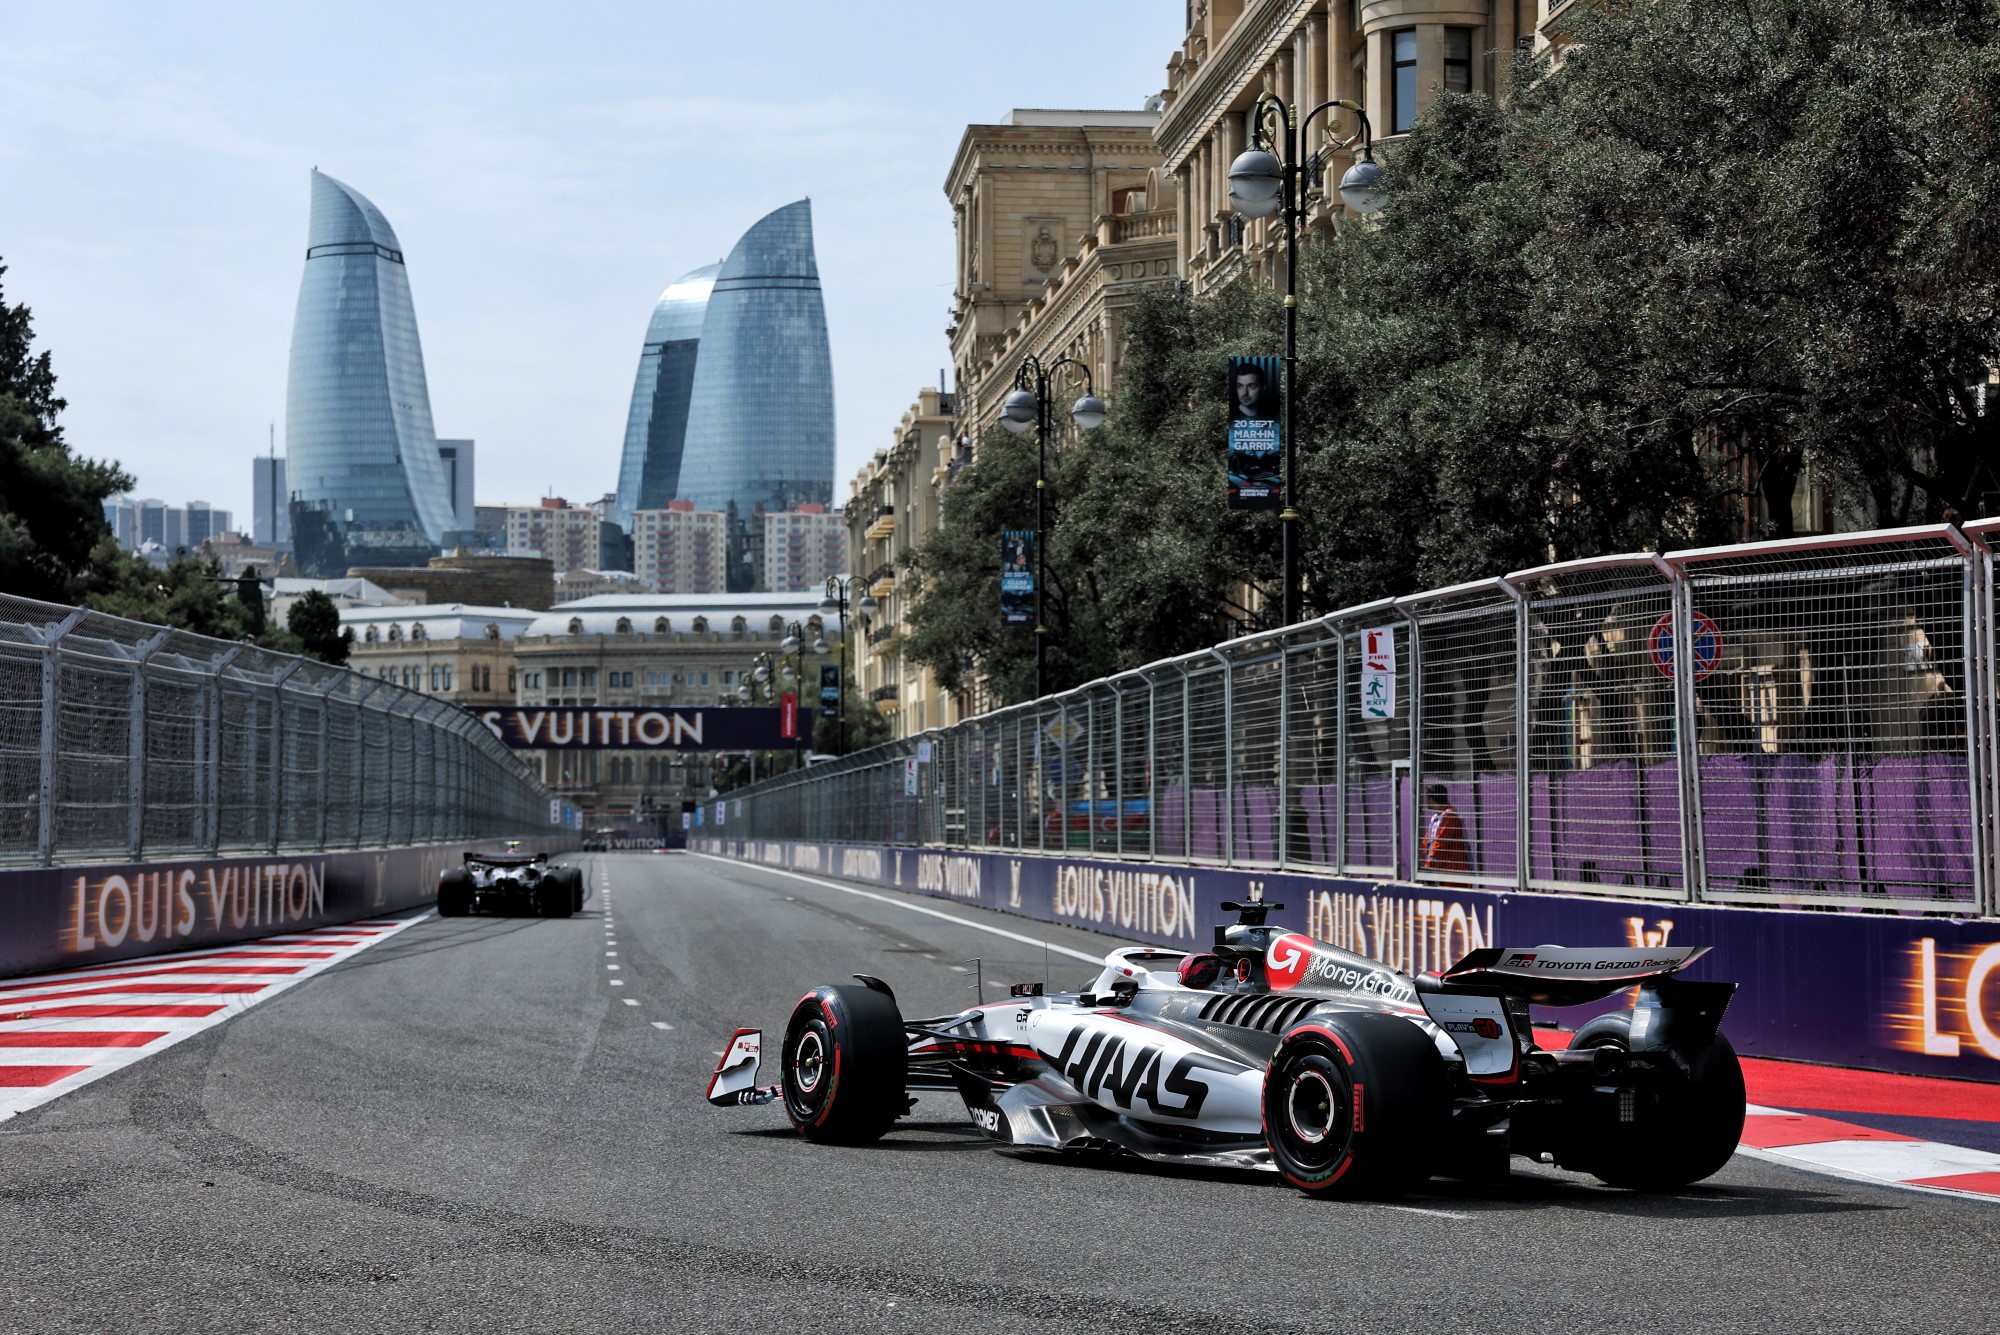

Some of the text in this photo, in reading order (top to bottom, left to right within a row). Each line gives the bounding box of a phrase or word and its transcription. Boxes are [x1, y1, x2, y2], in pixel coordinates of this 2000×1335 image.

[1234, 420, 1274, 428] 20 SEPT
[1234, 442, 1274, 451] GARRIX
[517, 711, 703, 746] VUITTON
[76, 869, 196, 950] LOUIS
[207, 861, 325, 932] VUITTON
[1058, 865, 1104, 922] LOUIS
[1108, 869, 1196, 940] VUITTON
[1309, 957, 1413, 1002] MoneyGram
[1537, 960, 1591, 970] TOYOTA
[1594, 961, 1640, 970] GAZOO
[1641, 958, 1681, 968] Racing
[1475, 1019, 1499, 1038] GO
[1037, 1022, 1253, 1120] HAAS
[968, 1106, 1000, 1132] ZOOMEX
[1353, 1083, 1364, 1133] PIRELLI
